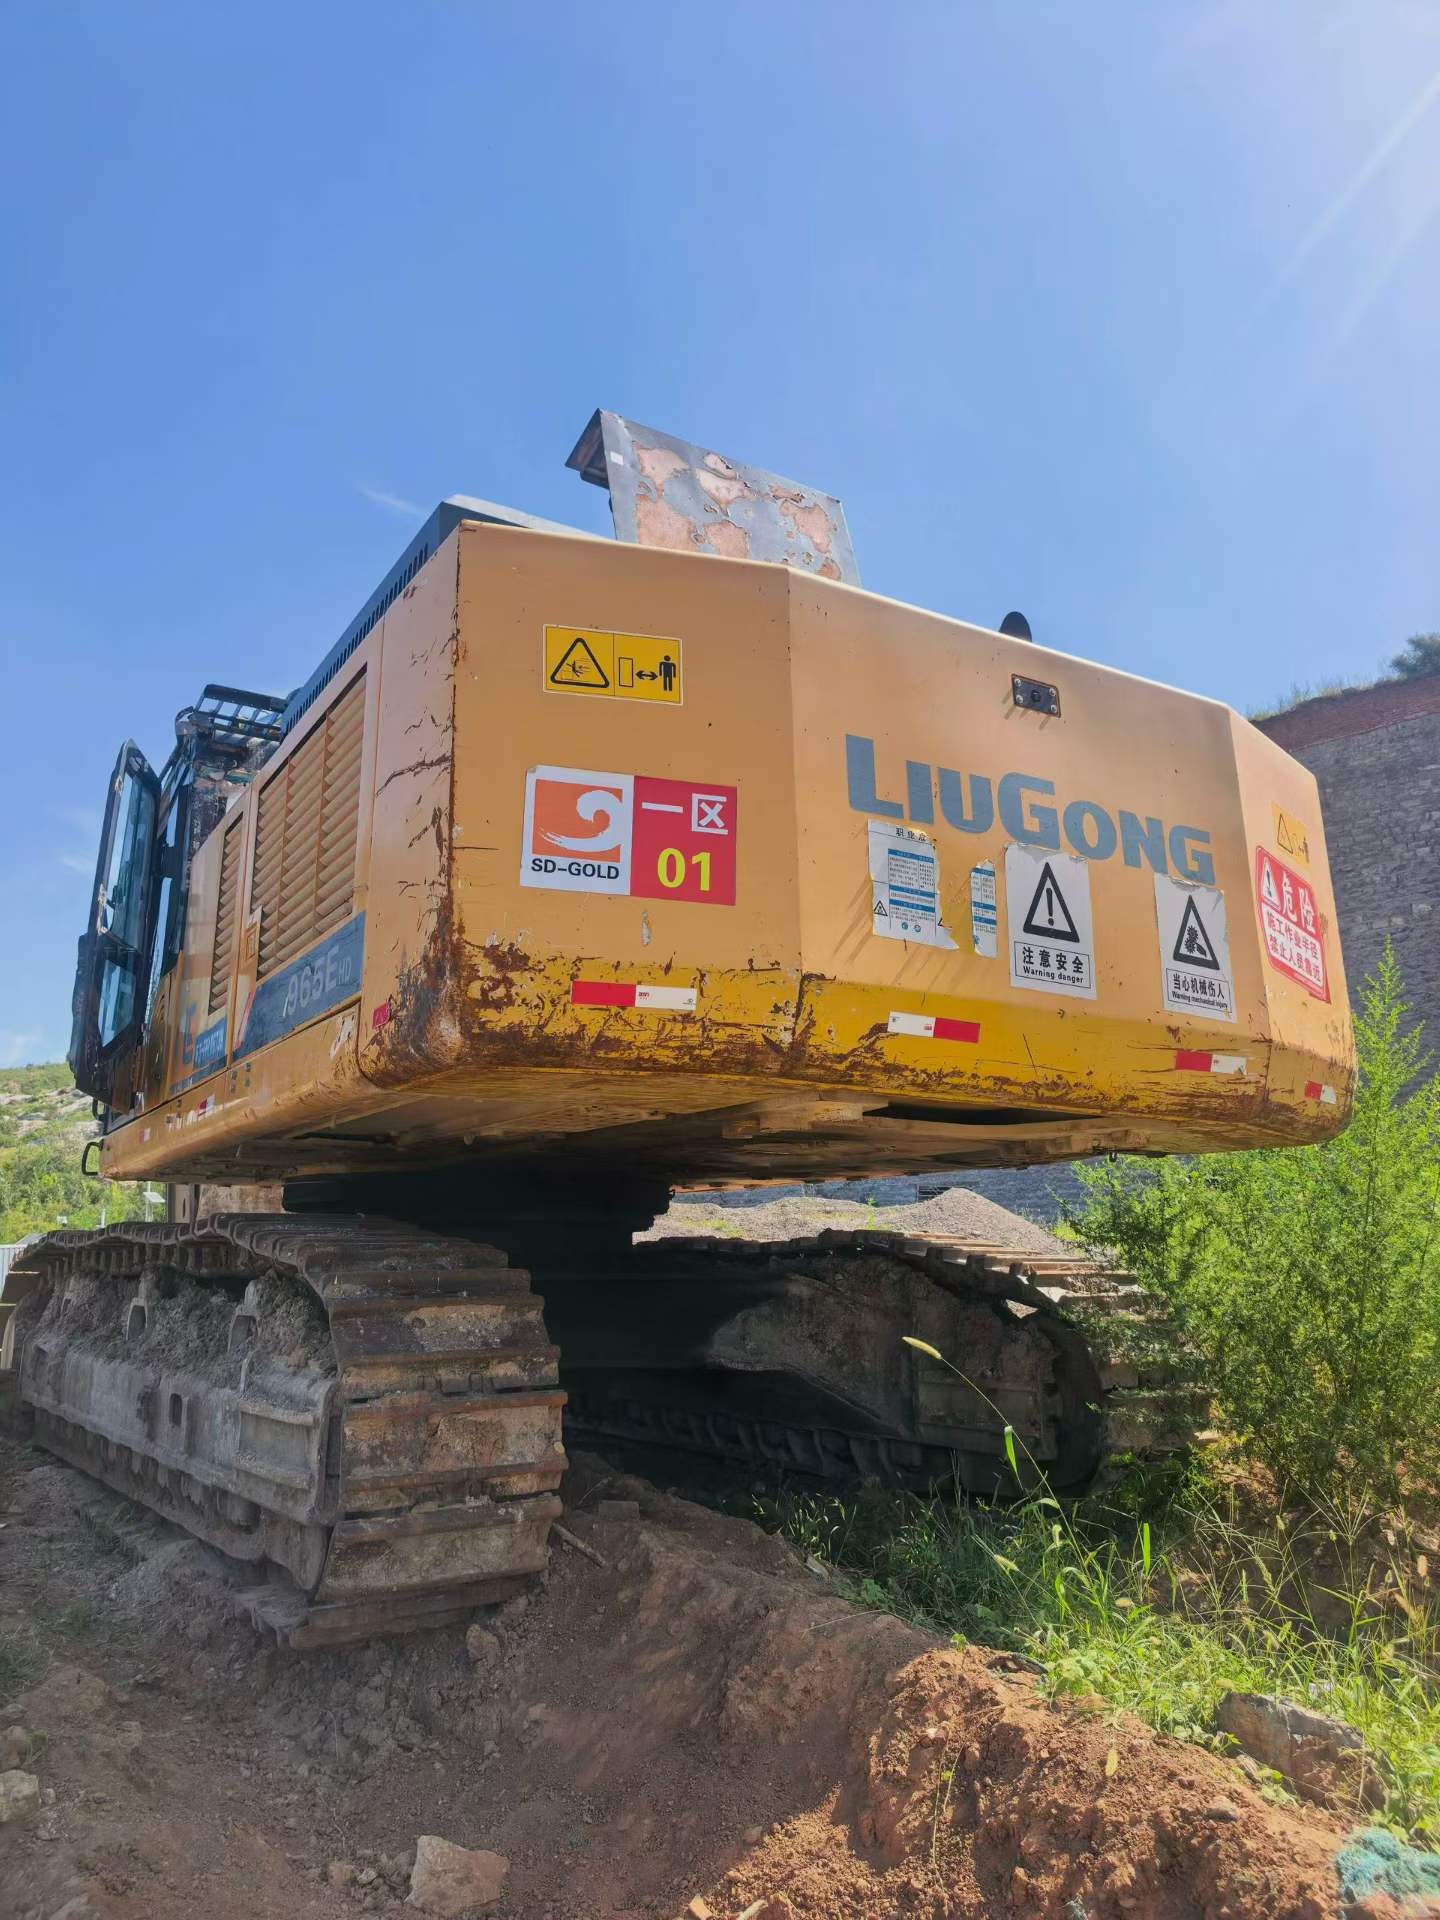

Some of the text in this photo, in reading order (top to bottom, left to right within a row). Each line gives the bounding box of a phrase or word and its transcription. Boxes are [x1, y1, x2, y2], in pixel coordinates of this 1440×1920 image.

[641, 793, 729, 835] 一区
[845, 733, 1215, 885] LIUGONG
[531, 858, 620, 880] SD-GOLD
[657, 847, 711, 892] 01
[1281, 870, 1316, 934] 危险
[1022, 946, 1084, 974] 注意安全
[1023, 965, 1084, 984] Warning danger
[1173, 973, 1225, 999] 当心机械伤人
